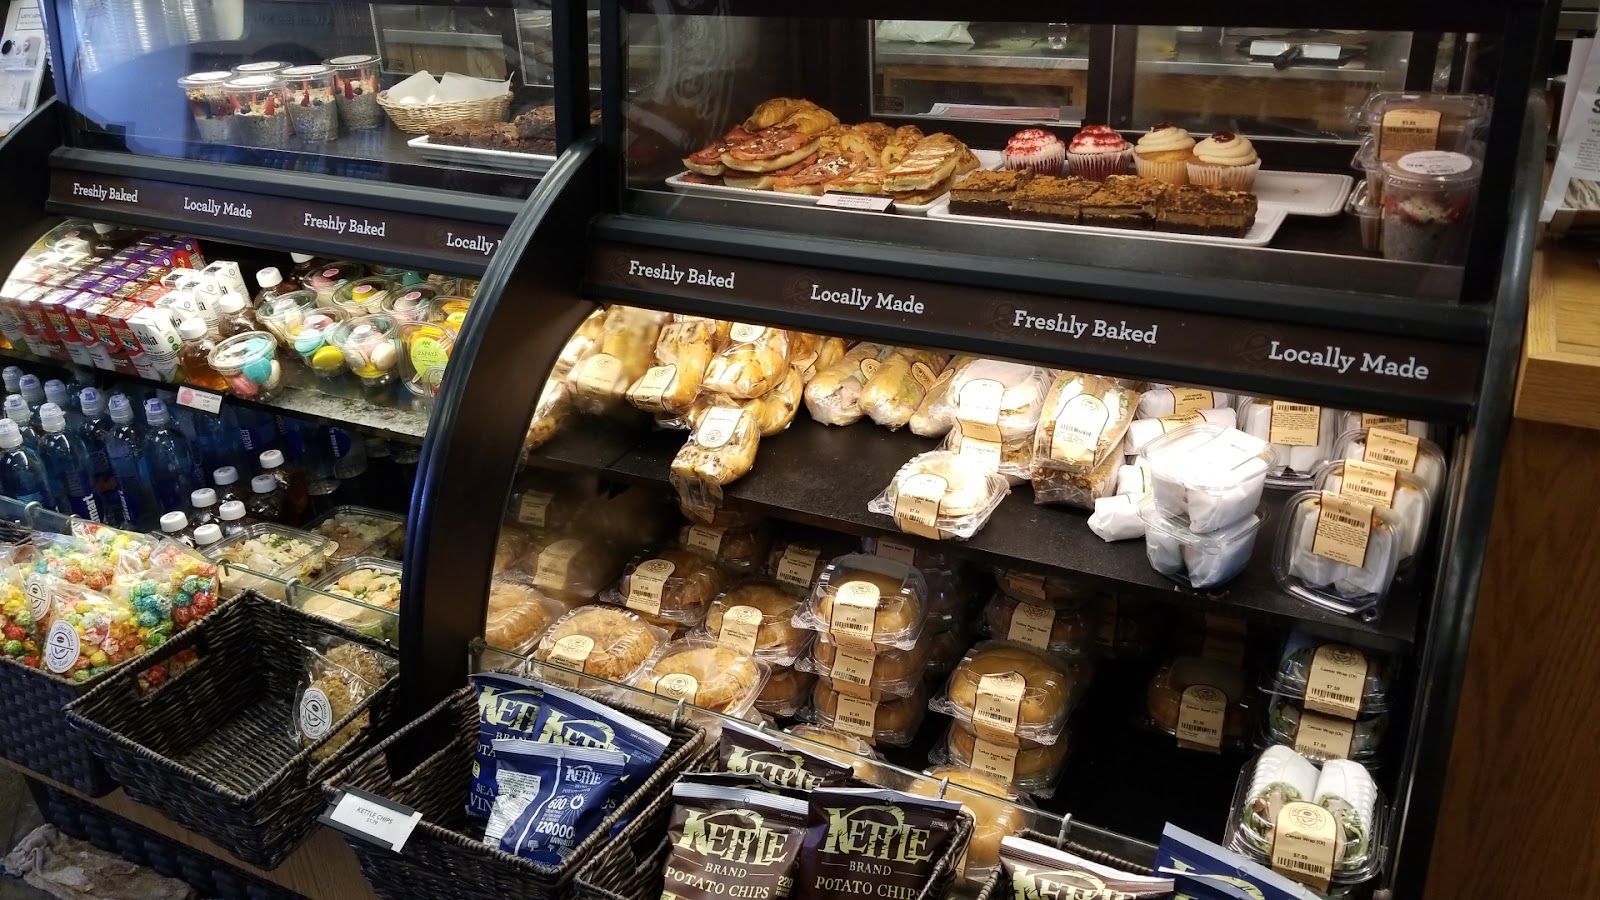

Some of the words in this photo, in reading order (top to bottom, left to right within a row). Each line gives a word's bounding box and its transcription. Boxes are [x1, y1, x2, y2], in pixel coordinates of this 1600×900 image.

[73, 183, 107, 201] Freshly
[109, 187, 138, 203] Baked
[184, 197, 221, 217] Locally
[223, 202, 253, 219] Made
[303, 212, 347, 235] Freshly
[349, 218, 386, 237] Baked
[446, 232, 494, 255] Locally
[629, 260, 685, 285] Freshly
[687, 267, 735, 289] Baked
[810, 284, 872, 311] Locally
[875, 293, 925, 315] Made
[1013, 309, 1088, 339] Freshly
[1091, 319, 1158, 345] Baked
[1268, 341, 1356, 373] Locally
[1360, 352, 1430, 380] Made
[82, 493, 101, 523] mart
[356, 806, 377, 819] KETTLE
[376, 814, 394, 825] CHIPS
[547, 797, 568, 811] 600
[672, 808, 790, 867] KETTLE
[818, 805, 935, 865] KETTLE
[704, 862, 748, 879] BRAND
[848, 860, 893, 877] BRAND
[664, 866, 725, 895] POTATO
[728, 884, 770, 899] CHIPS
[777, 875, 794, 889] 220
[814, 875, 874, 896] POTATO
